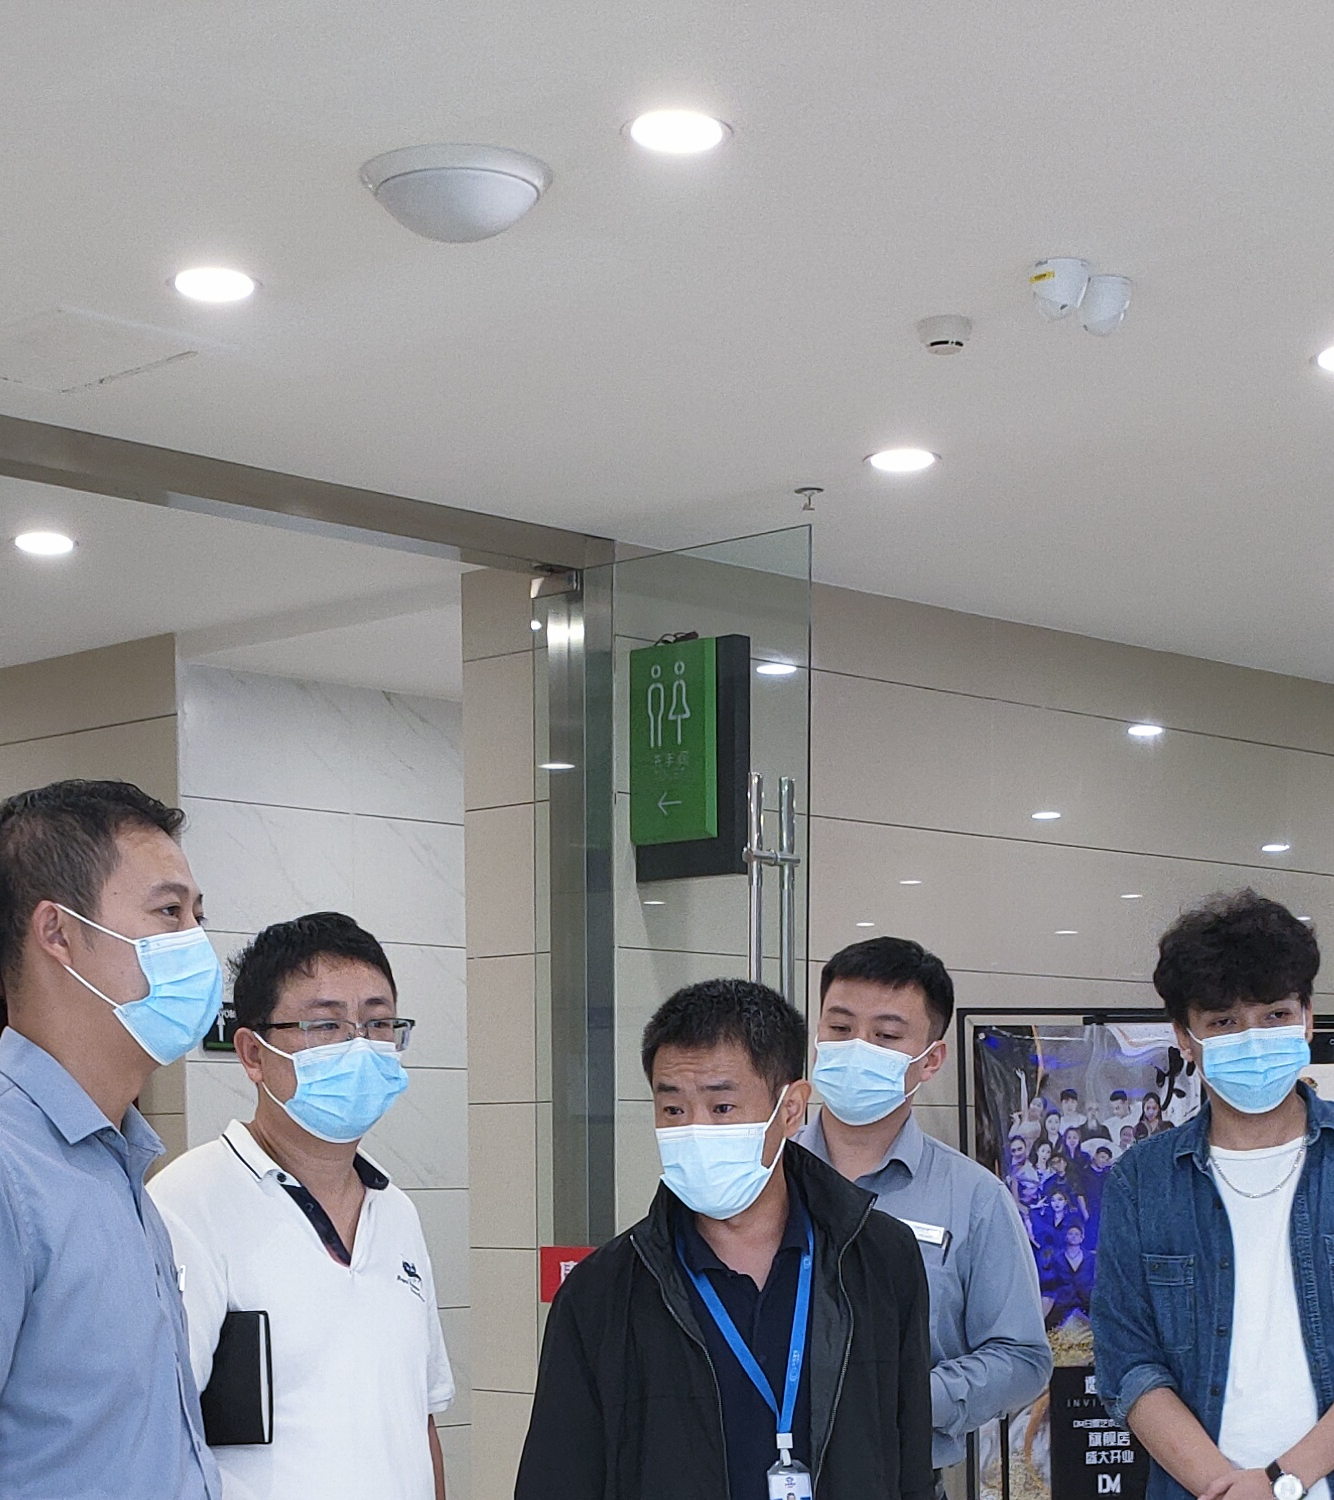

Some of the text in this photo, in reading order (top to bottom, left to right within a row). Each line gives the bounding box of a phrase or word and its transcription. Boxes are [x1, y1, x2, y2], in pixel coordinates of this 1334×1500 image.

[1088, 1431, 1131, 1447] 旗舰店
[1085, 1449, 1135, 1465] 盛大开业
